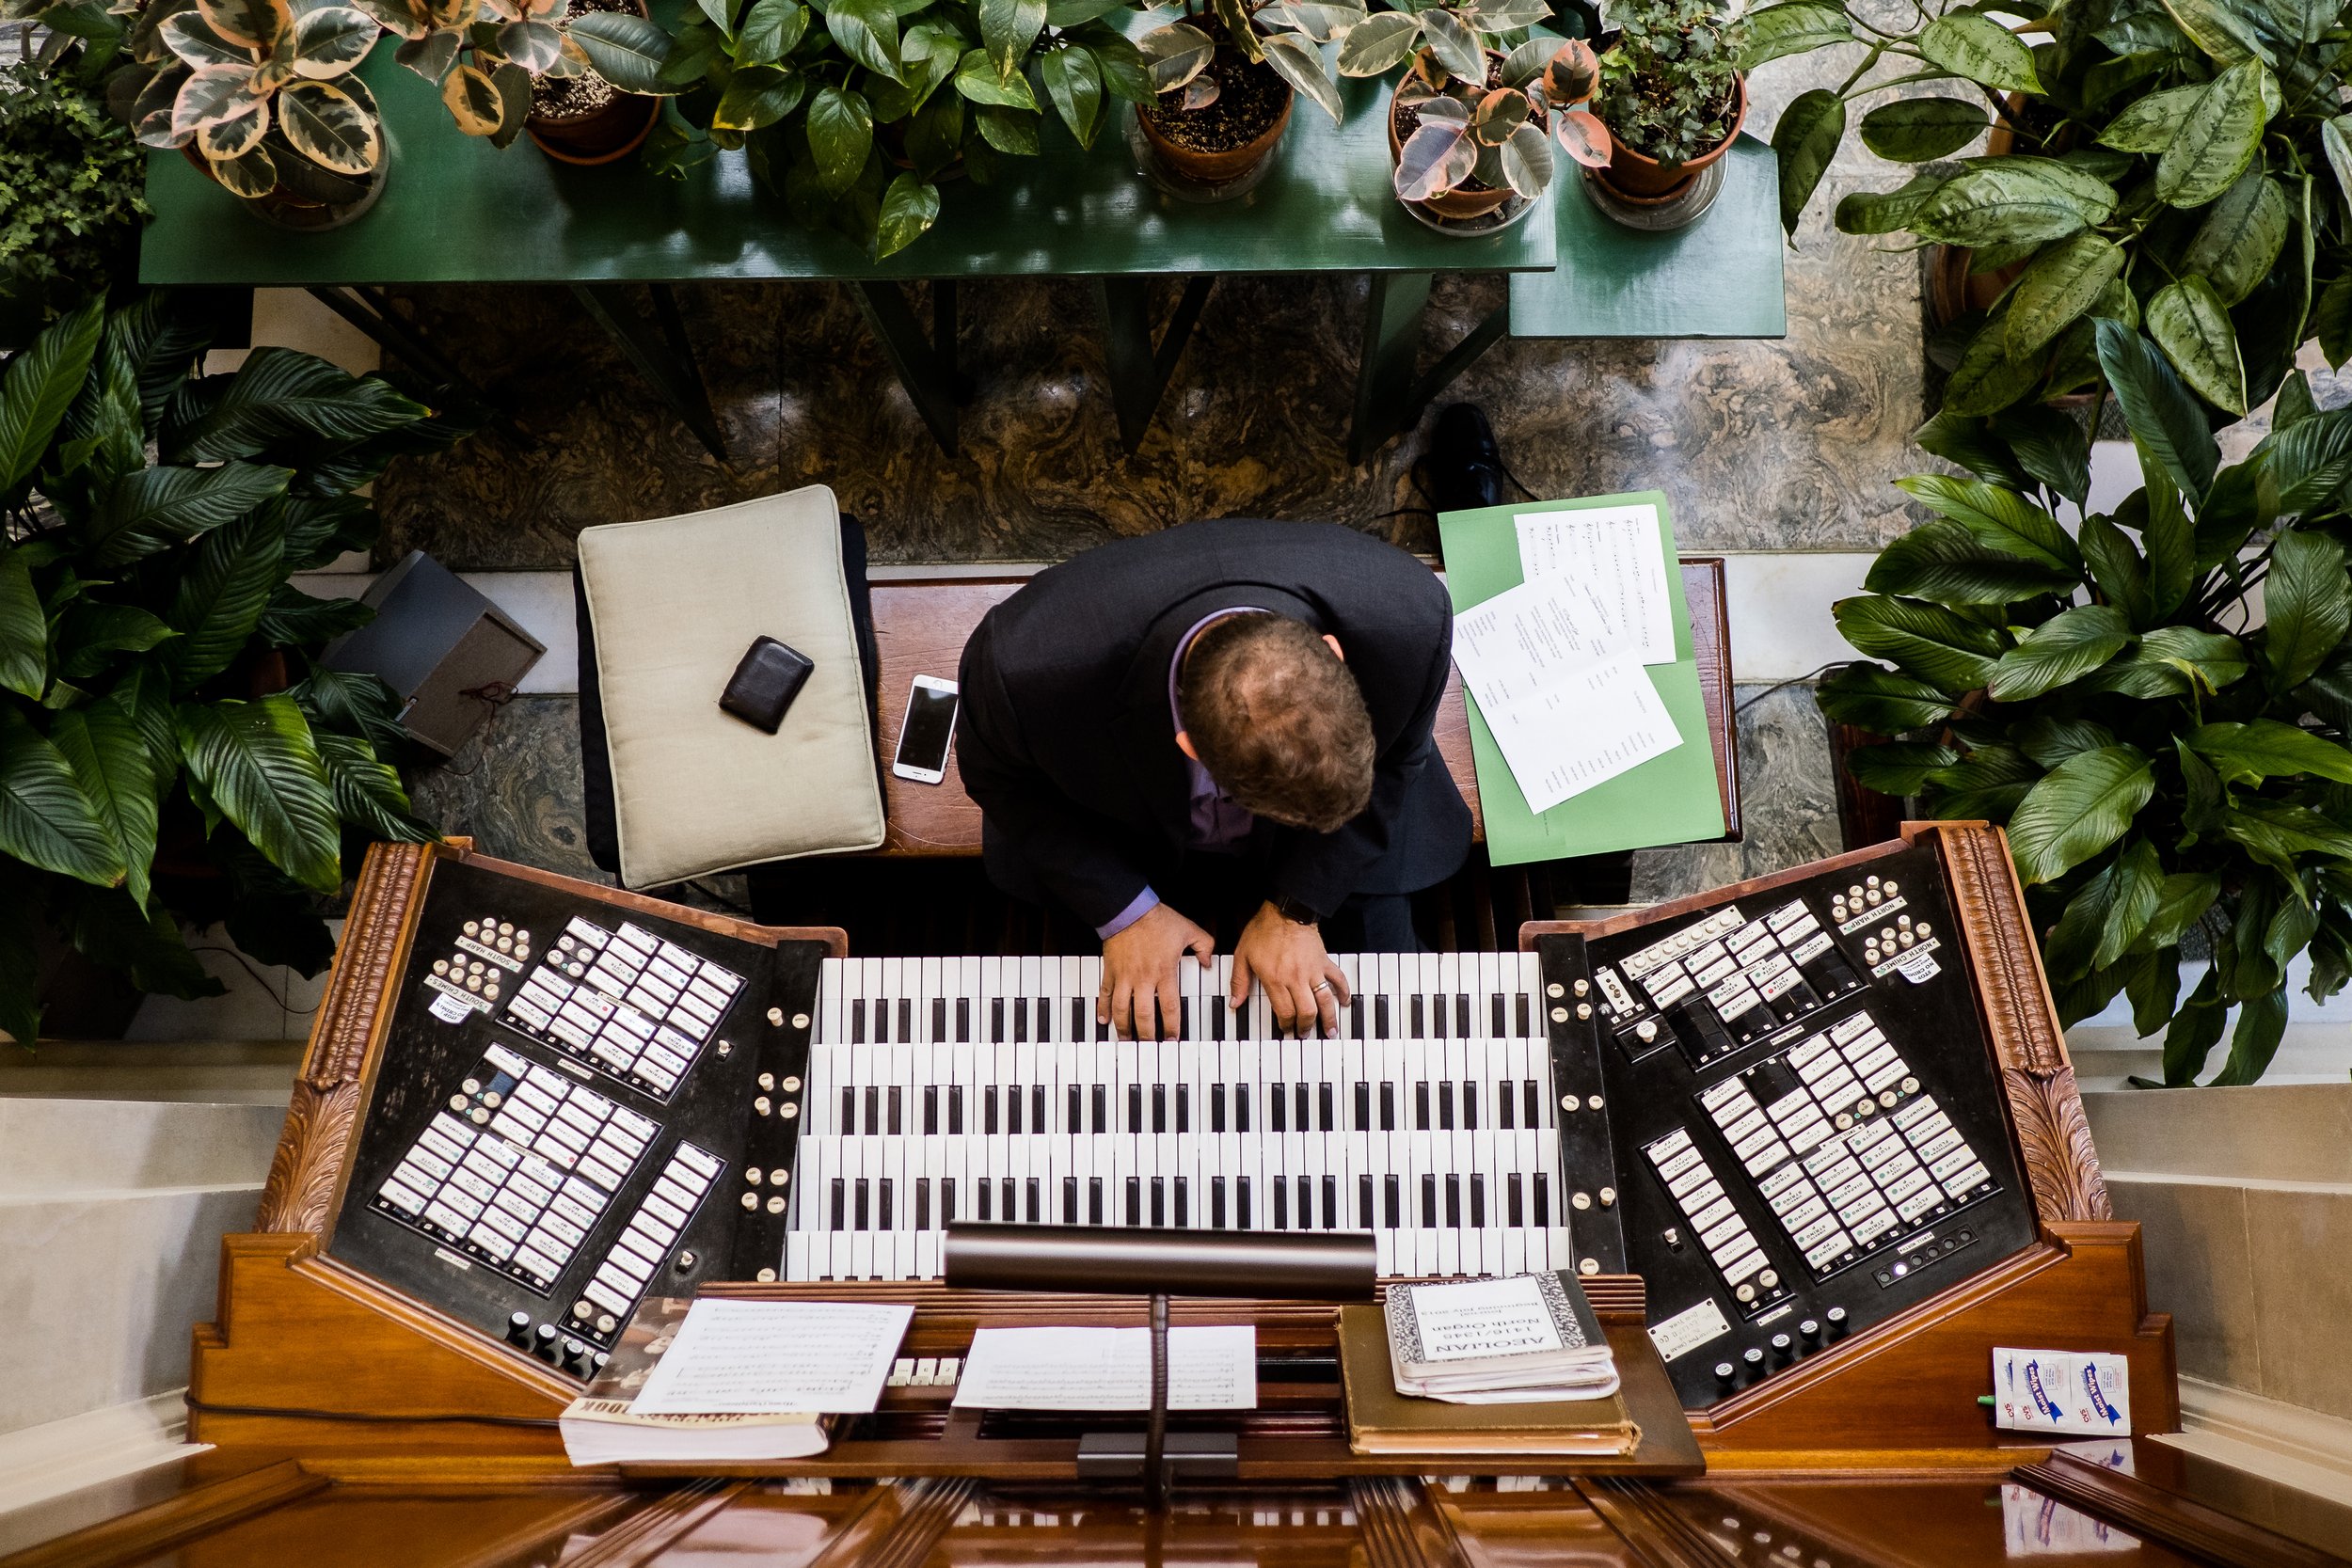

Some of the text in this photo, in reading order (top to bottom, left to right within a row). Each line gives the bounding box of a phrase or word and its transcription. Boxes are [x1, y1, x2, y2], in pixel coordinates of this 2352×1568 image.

[1849, 901, 1895, 929] NORTH HARP
[465, 941, 511, 966] SOUTH HARP
[1907, 941, 1932, 958] NORTH
[1879, 954, 1908, 973] CHIMES
[431, 977, 460, 995] CHIMES
[459, 991, 485, 1007] SOUTH
[1730, 998, 1747, 1011] FLUTE
[1431, 1318, 1539, 1332] North Organ
[1435, 1337, 1544, 1352] AEOLIAN
[2028, 1366, 2041, 1391] Wipes
[2086, 1369, 2098, 1395] Wipes
[2021, 1404, 2032, 1420] CVS
[2035, 1390, 2051, 1416] Moist
[2093, 1393, 2109, 1418] Moist
[2079, 1407, 2090, 1423] CVS
